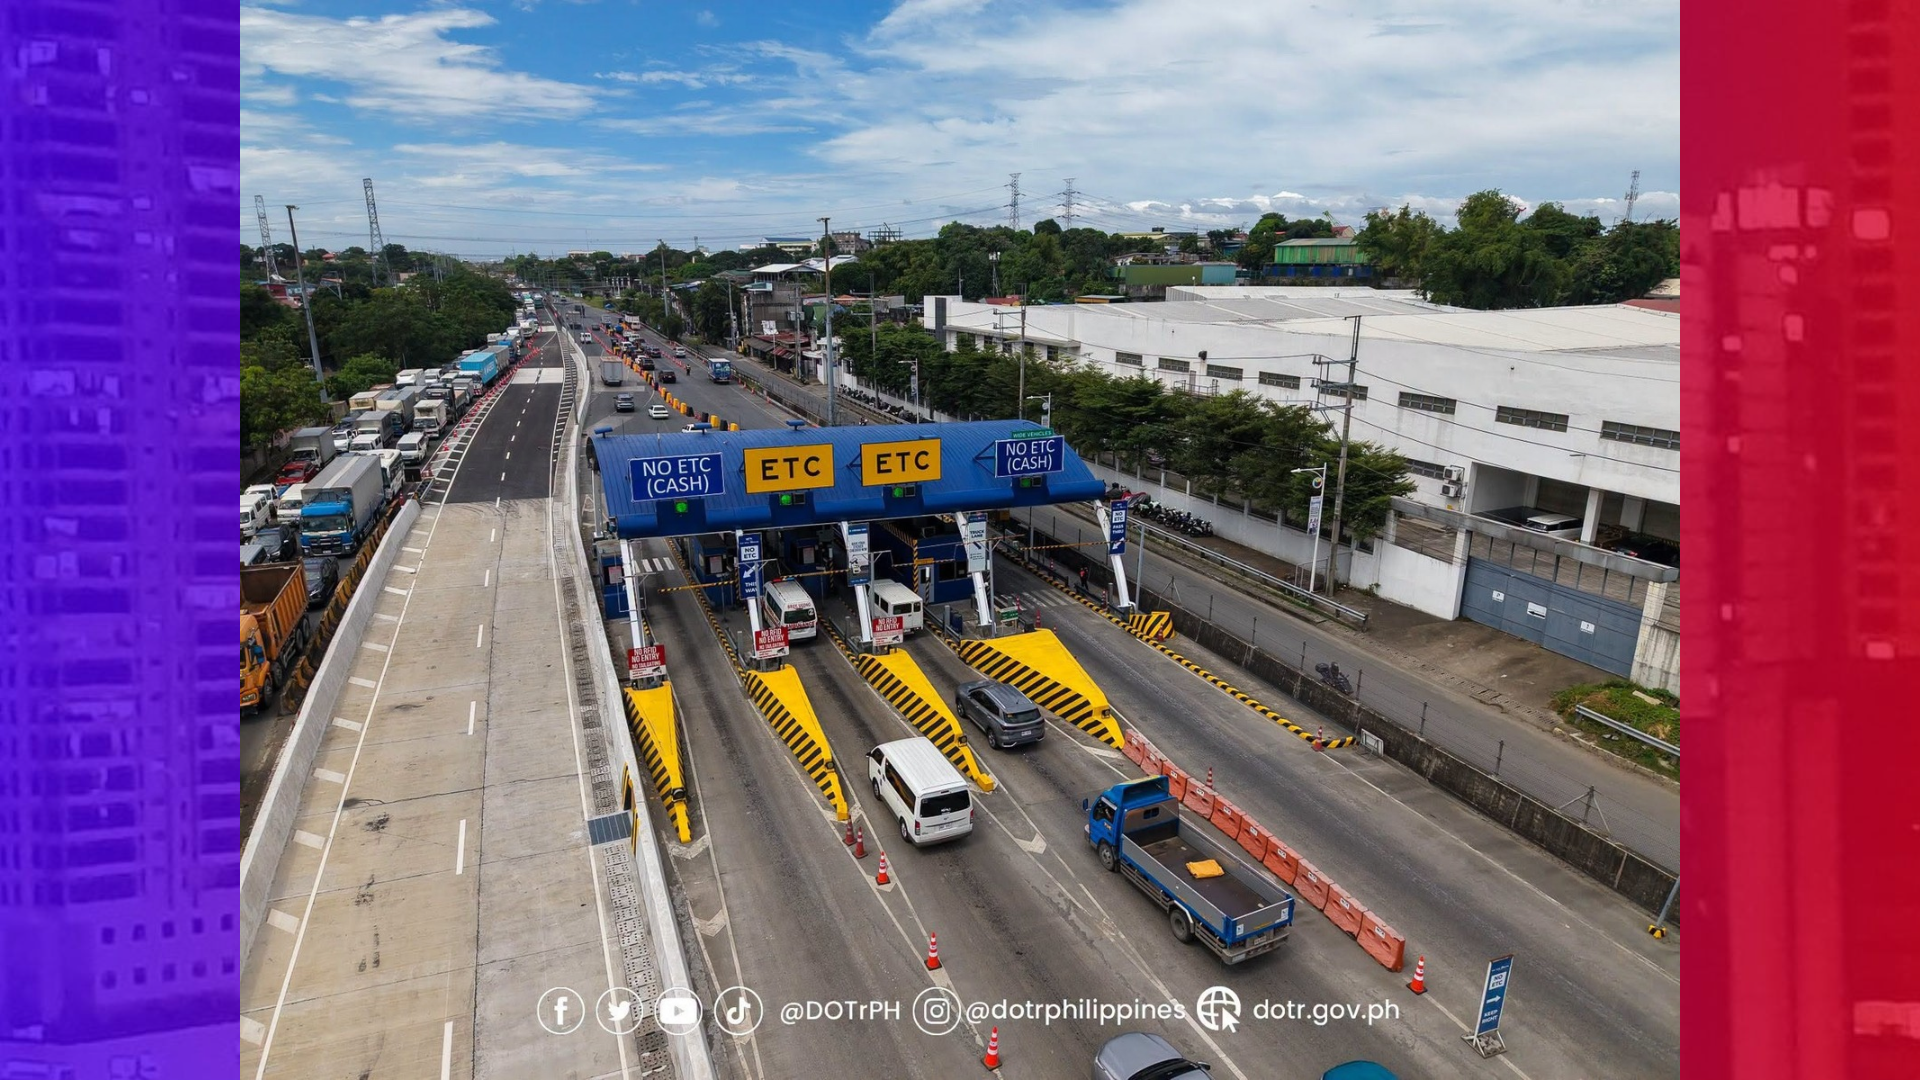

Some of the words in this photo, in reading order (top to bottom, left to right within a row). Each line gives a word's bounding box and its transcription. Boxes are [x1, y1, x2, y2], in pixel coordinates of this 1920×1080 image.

[1006, 442, 1027, 456] NO
[1031, 439, 1055, 454] ETC
[643, 460, 672, 477] NO
[678, 457, 711, 474] ETC
[761, 456, 821, 480] ETC
[877, 450, 929, 474] ETC
[1007, 454, 1052, 474] (CASH)
[647, 474, 709, 498] (CASH)
[769, 628, 781, 636] RFID
[883, 622, 900, 630] ENTRY
[767, 634, 784, 643] ENTRY
[631, 655, 640, 663] NO
[641, 652, 660, 662] ENTRY
[634, 648, 643, 656] NO
[643, 646, 657, 654] RFID
[1482, 1015, 1498, 1024] RIGHT
